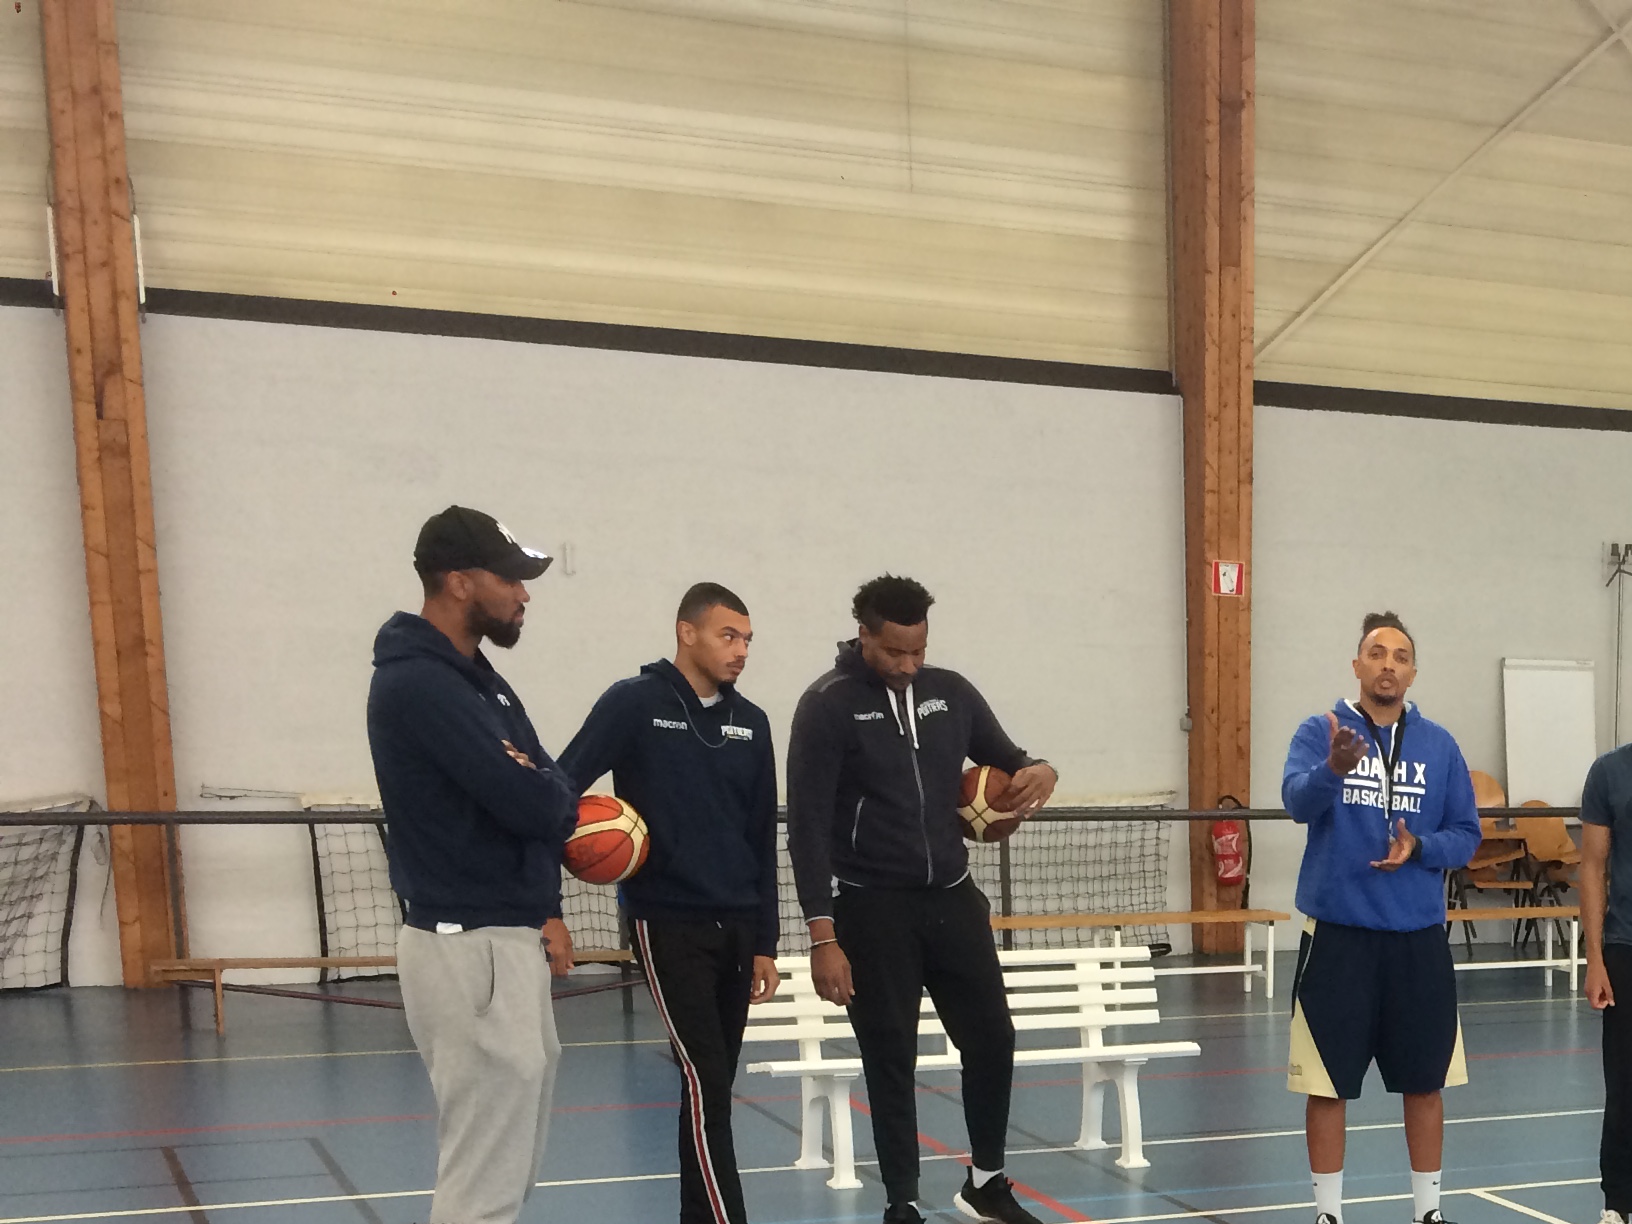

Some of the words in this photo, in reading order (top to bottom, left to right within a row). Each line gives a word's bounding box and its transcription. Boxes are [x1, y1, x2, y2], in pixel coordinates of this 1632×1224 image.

[1347, 755, 1407, 783] OAH
[1413, 762, 1427, 785] X
[1342, 788, 1422, 814] BASKEBALL
